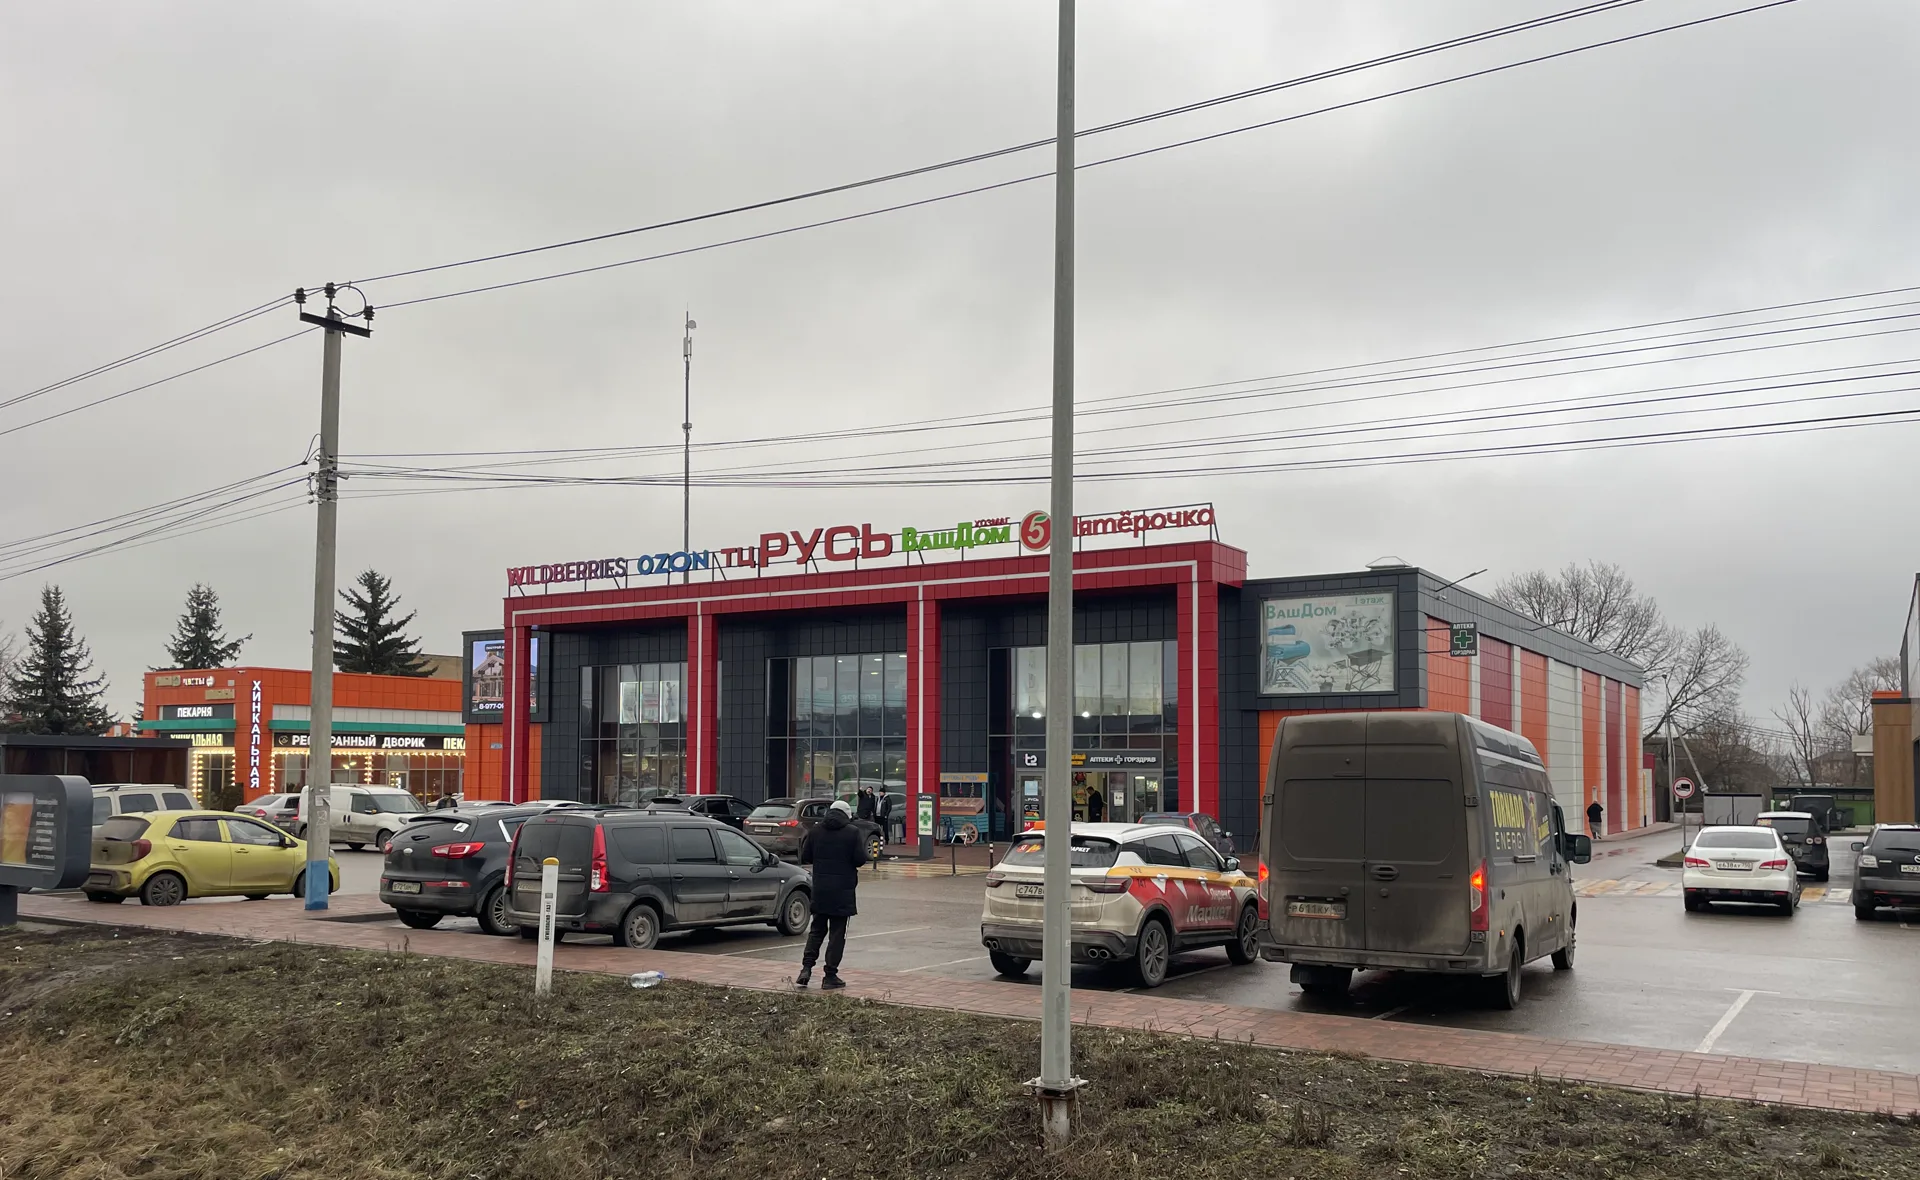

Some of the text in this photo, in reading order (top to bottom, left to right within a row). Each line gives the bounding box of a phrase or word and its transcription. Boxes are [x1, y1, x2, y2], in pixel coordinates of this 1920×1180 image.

[720, 523, 893, 568] ТЦ РУСЬ
[507, 556, 628, 587] WILDBERRIES
[637, 549, 710, 576] OZON
[177, 706, 213, 718] ПЕКАРНЯ
[249, 680, 262, 789] ХИНКАЛЬНАЯ
[381, 736, 426, 749] ДВОРИК
[1089, 756, 1114, 764] АПТЕКИ
[1124, 756, 1157, 764] ГОРЗДРАВ
[1489, 789, 1526, 830] TORNADO
[1494, 831, 1526, 850] ENERGY
[1018, 885, 1044, 895] С747В
[1209, 888, 1232, 900] Яндекс
[1186, 904, 1232, 923] Маркет
